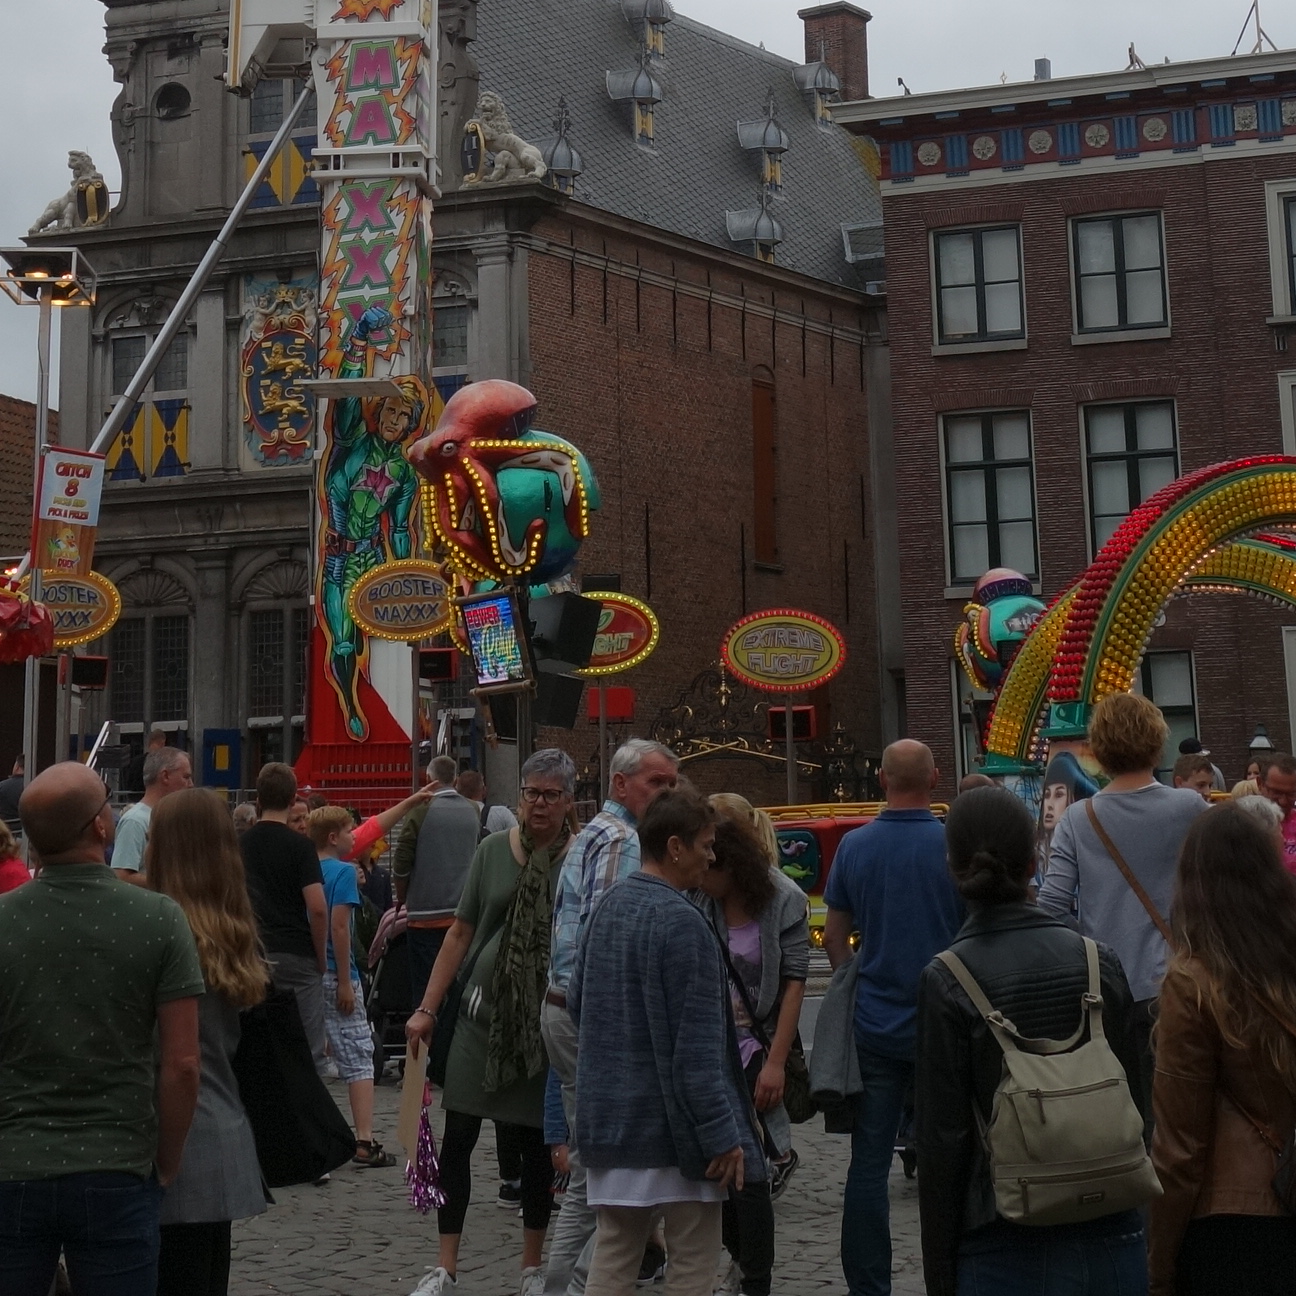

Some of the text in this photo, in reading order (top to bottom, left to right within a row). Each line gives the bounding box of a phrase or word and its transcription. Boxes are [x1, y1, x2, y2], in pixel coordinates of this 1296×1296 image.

[55, 462, 93, 478] CATCH
[65, 479, 79, 496] 8
[57, 558, 75, 568] DUCK
[368, 579, 445, 602] BOOSTER
[374, 603, 440, 622] MAXXX
[465, 606, 500, 629] POWER
[742, 627, 825, 652] EXTREME
[747, 652, 818, 674] FLIGHT
